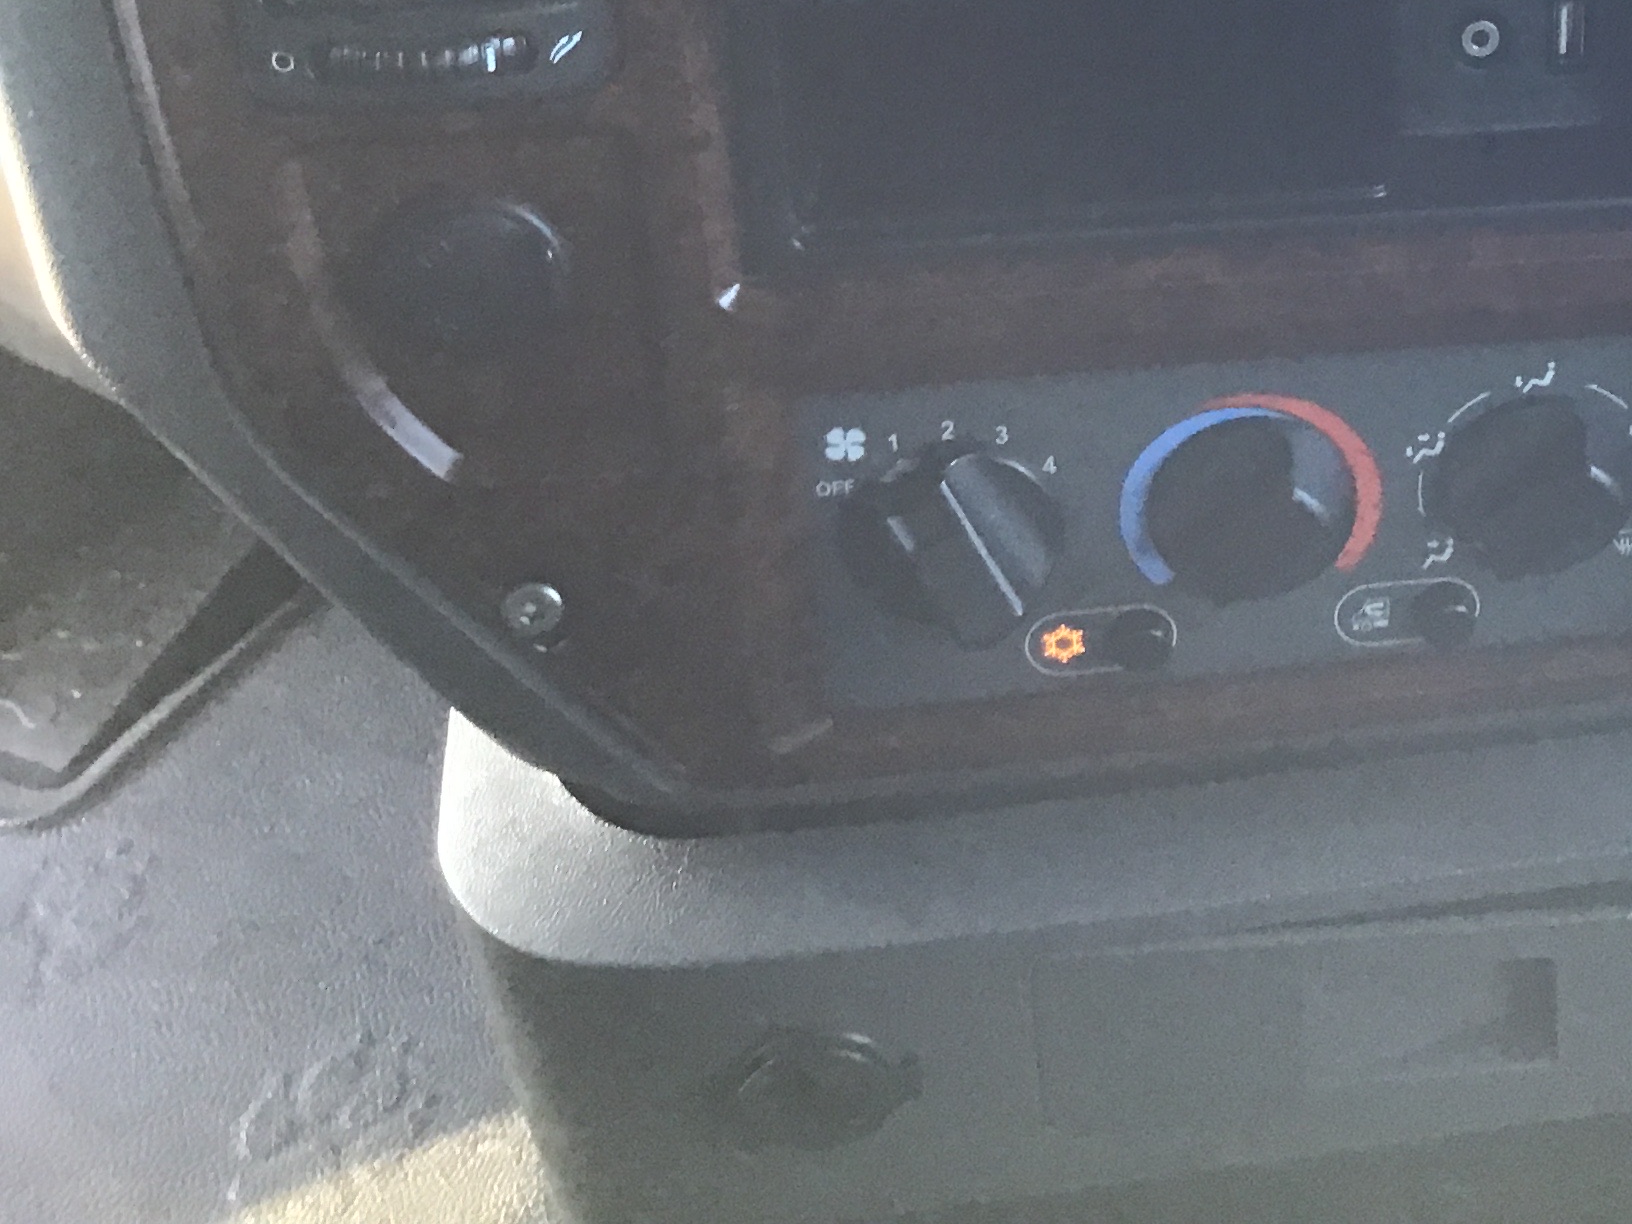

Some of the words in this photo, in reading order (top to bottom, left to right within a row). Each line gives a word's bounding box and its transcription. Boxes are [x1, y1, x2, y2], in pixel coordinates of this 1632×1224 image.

[940, 420, 956, 441] 2
[995, 426, 1009, 445] 3
[888, 433, 899, 453] 1
[1041, 455, 1058, 475] 4
[815, 478, 856, 498] OFF
